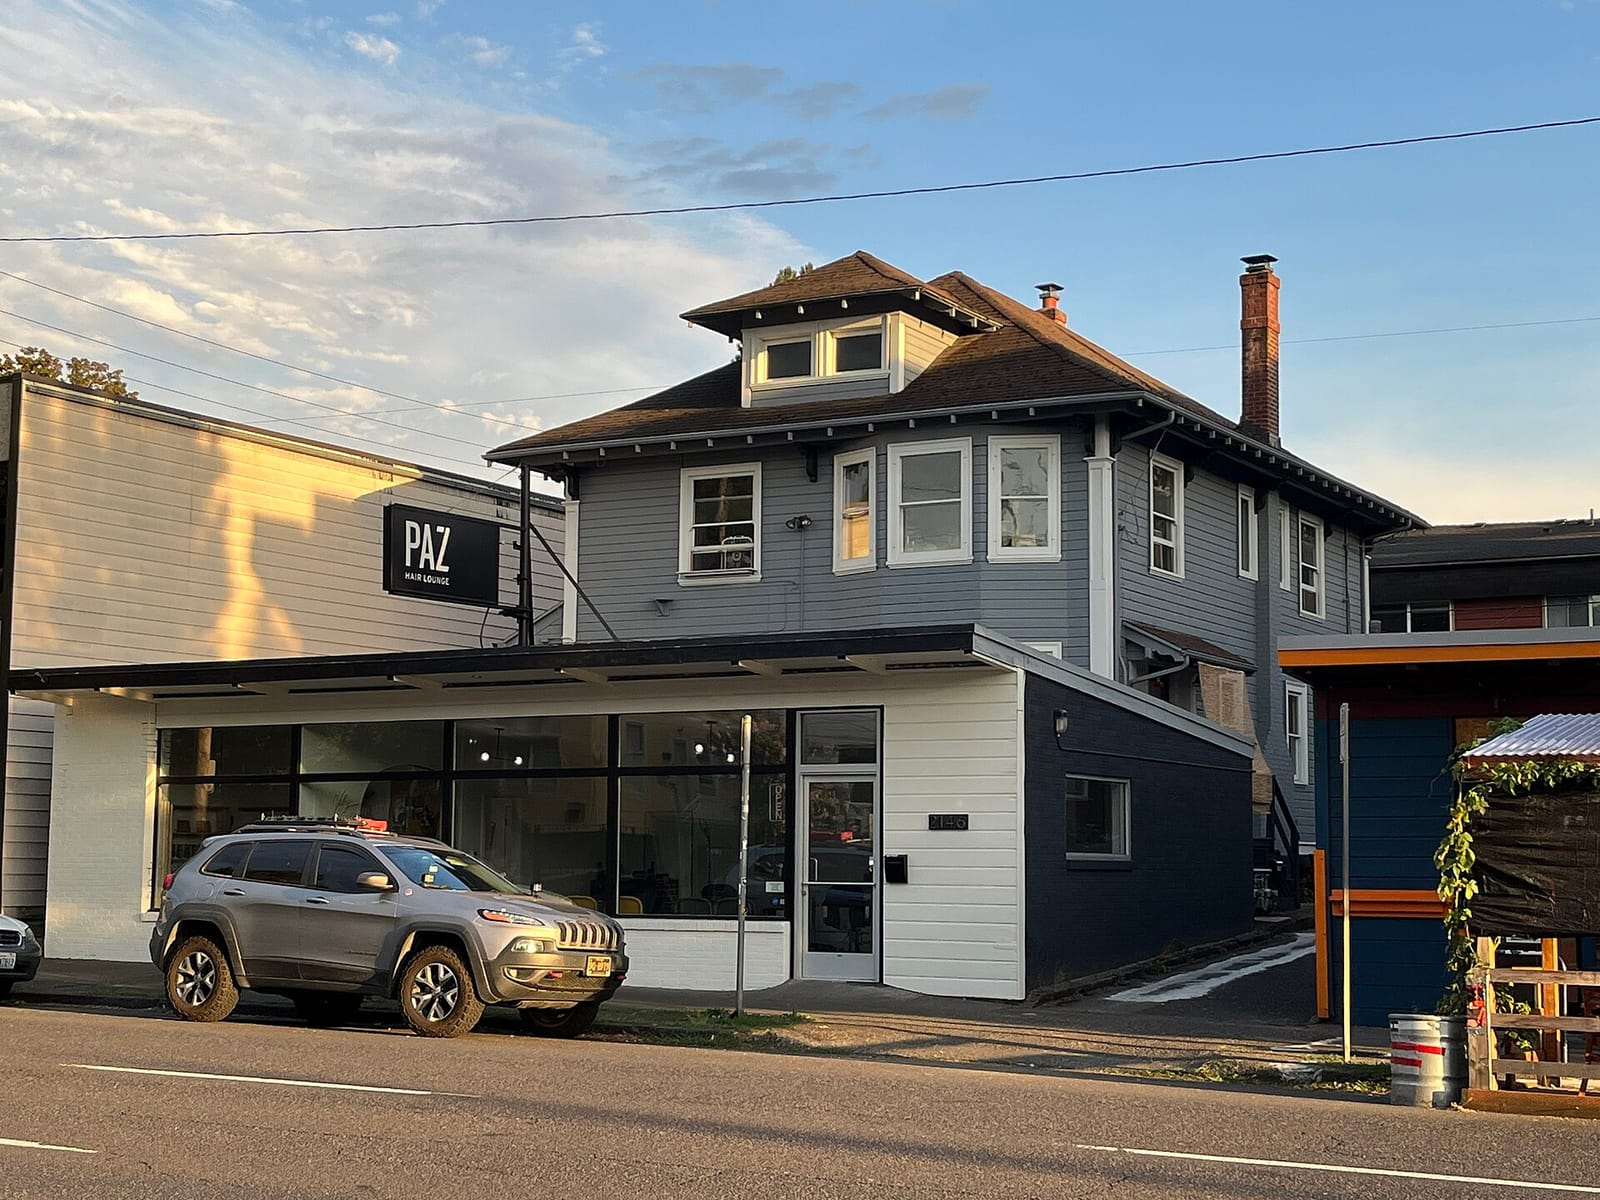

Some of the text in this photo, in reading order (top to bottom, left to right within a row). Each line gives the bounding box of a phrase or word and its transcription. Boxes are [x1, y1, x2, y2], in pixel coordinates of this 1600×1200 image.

[405, 520, 451, 573] PAZ
[404, 571, 450, 586] HAIR LOUNGE
[775, 785, 783, 820] OPEN
